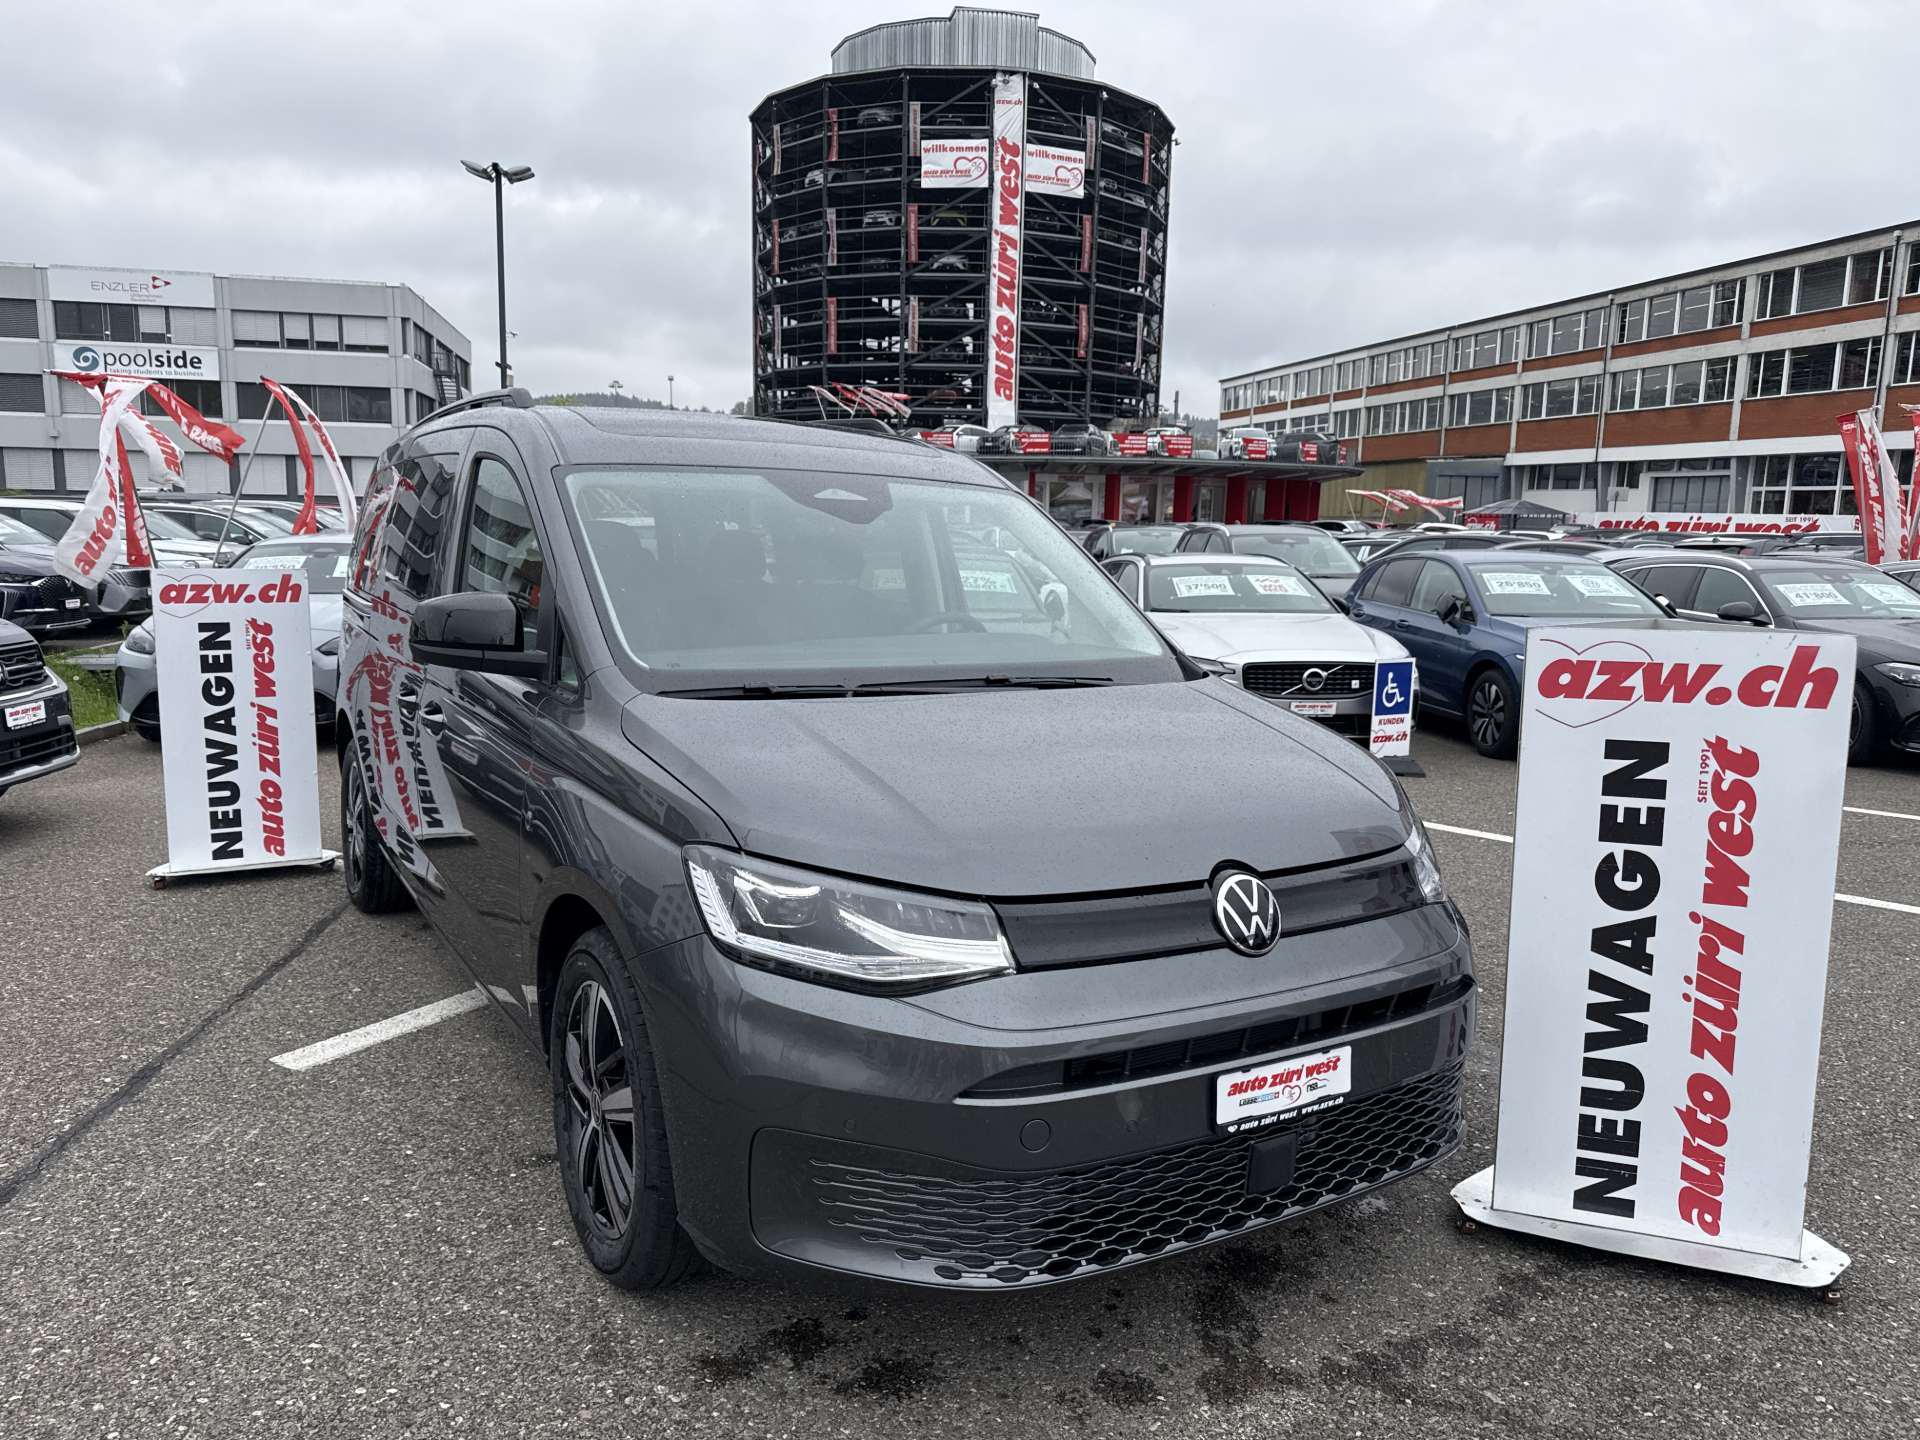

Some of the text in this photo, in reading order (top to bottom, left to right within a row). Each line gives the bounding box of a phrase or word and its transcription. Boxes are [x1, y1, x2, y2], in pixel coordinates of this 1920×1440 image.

[923, 143, 987, 153] willkommen
[1027, 149, 1084, 165] willkommen
[91, 280, 149, 293] ENZLER
[991, 136, 1021, 401] auto züri west
[103, 349, 203, 373] poolside
[174, 368, 204, 378] business
[74, 505, 117, 576] auto
[159, 574, 303, 605] azw.ch
[1537, 645, 1840, 710] azw.ch
[245, 617, 286, 857] auto züri west
[1372, 730, 1408, 743] azw.ch
[1378, 717, 1405, 726] KUNDEN
[198, 621, 244, 861] NEUWAGEN
[1697, 748, 1711, 803] SEIT 1991
[1572, 738, 1670, 1219] NEUWAGEN
[1673, 735, 1761, 1238] auto züri west
[1227, 1055, 1341, 1097] auto züri west
[1239, 1119, 1259, 1131] auto
[1279, 1109, 1298, 1121] west
